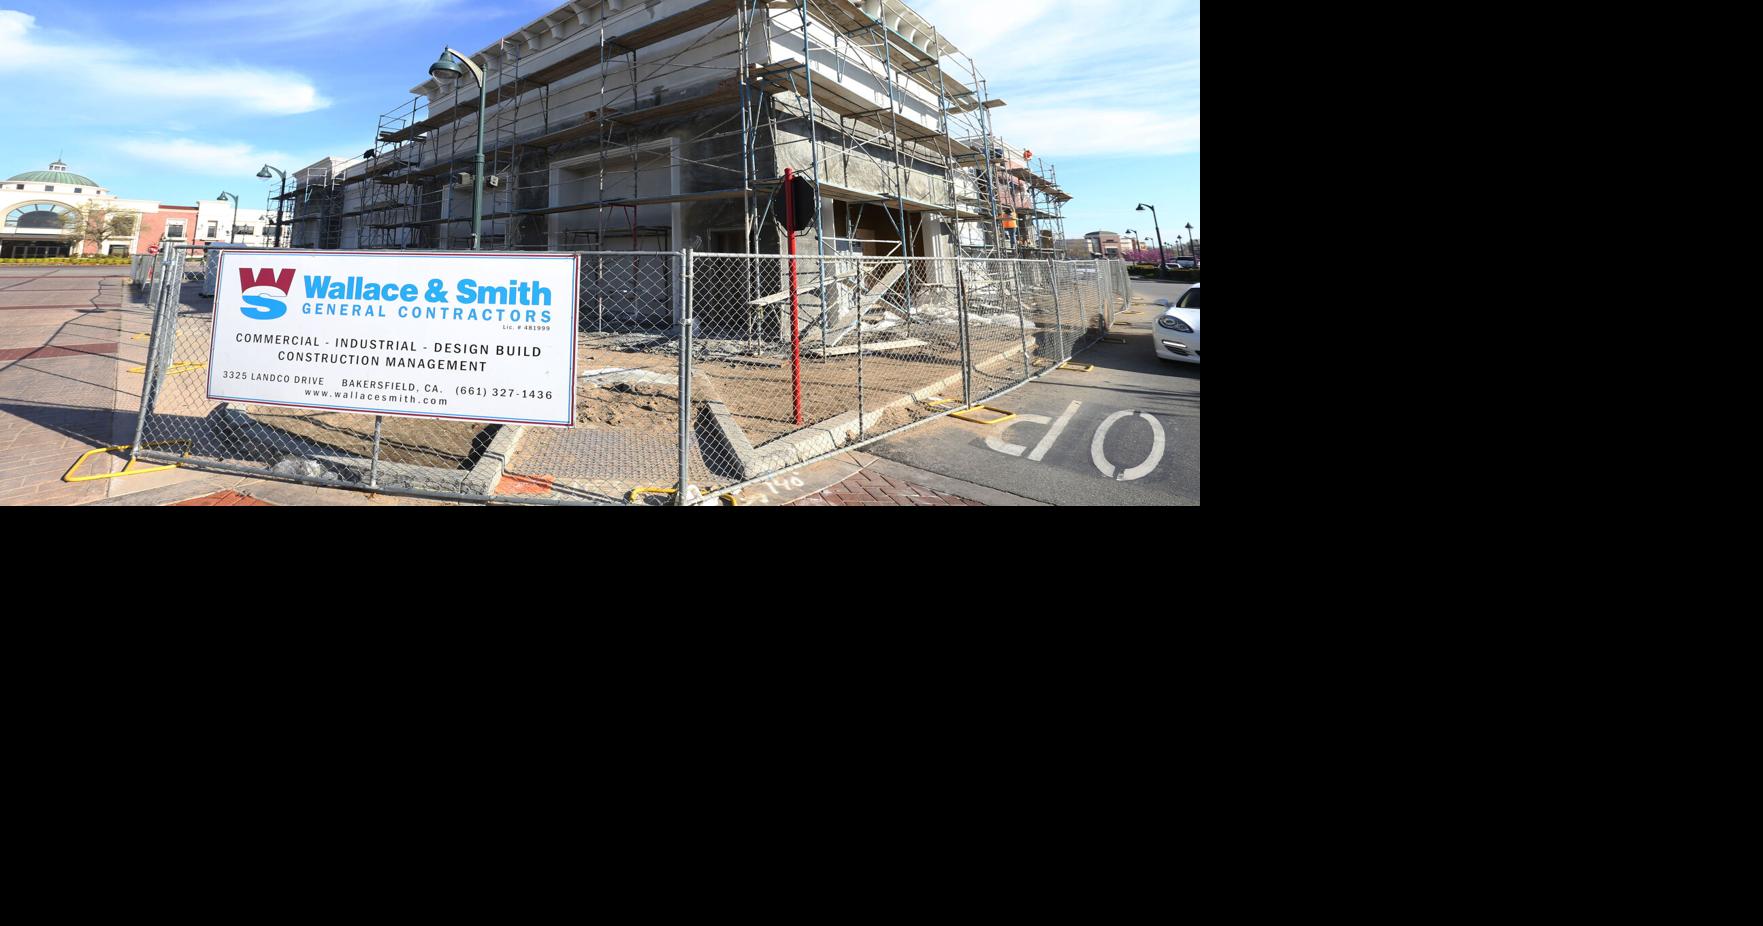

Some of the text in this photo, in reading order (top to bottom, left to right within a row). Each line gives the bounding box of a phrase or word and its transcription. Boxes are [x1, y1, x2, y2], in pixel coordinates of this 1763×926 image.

[304, 275, 551, 306] Wallace & Smith
[302, 303, 551, 323] GENERAL CONTRACTORS
[236, 333, 320, 346] COMMERCIAL
[335, 338, 417, 351] INDUSTRIAL
[434, 342, 489, 355] DESIGN
[496, 345, 542, 357] BUILD
[278, 350, 487, 372] CONSTRUCTION MANAGEMENT
[222, 371, 553, 400] 3325 LANDCO DRIVE BAKERSFIELD, CA. (661) 327-1436
[304, 389, 447, 405] www.wallacesmith.com
